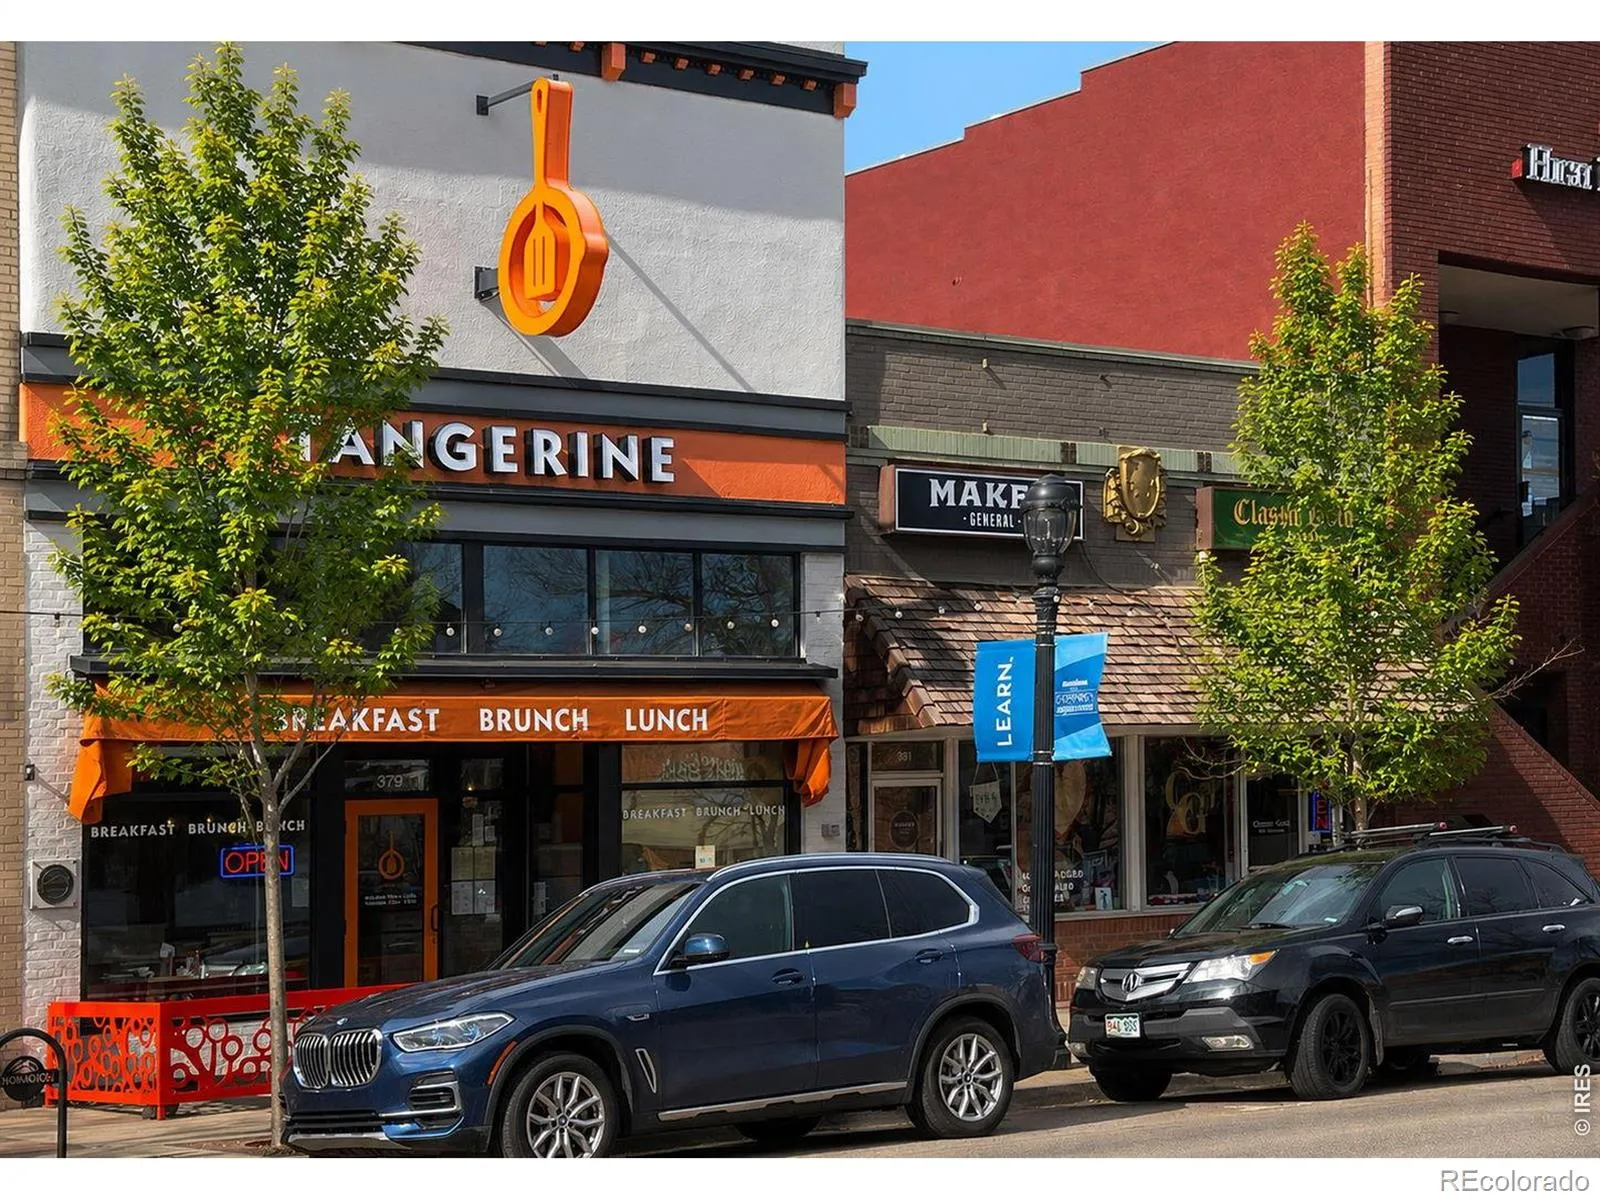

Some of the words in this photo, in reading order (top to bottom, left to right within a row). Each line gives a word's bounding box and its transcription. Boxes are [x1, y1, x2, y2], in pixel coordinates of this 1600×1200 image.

[929, 478, 1029, 509] MAKE
[969, 511, 1015, 528] GENERAL
[995, 656, 1014, 747] LEARN.
[479, 707, 588, 732] BRUNCH
[624, 707, 708, 732] LUNCH
[376, 774, 403, 788] 379
[622, 807, 686, 820] BREAKFAST
[696, 806, 740, 817] BRUNCH
[750, 804, 785, 816] LUNCH
[91, 824, 174, 838] BREAKFAST
[188, 821, 246, 834] BRUNCH
